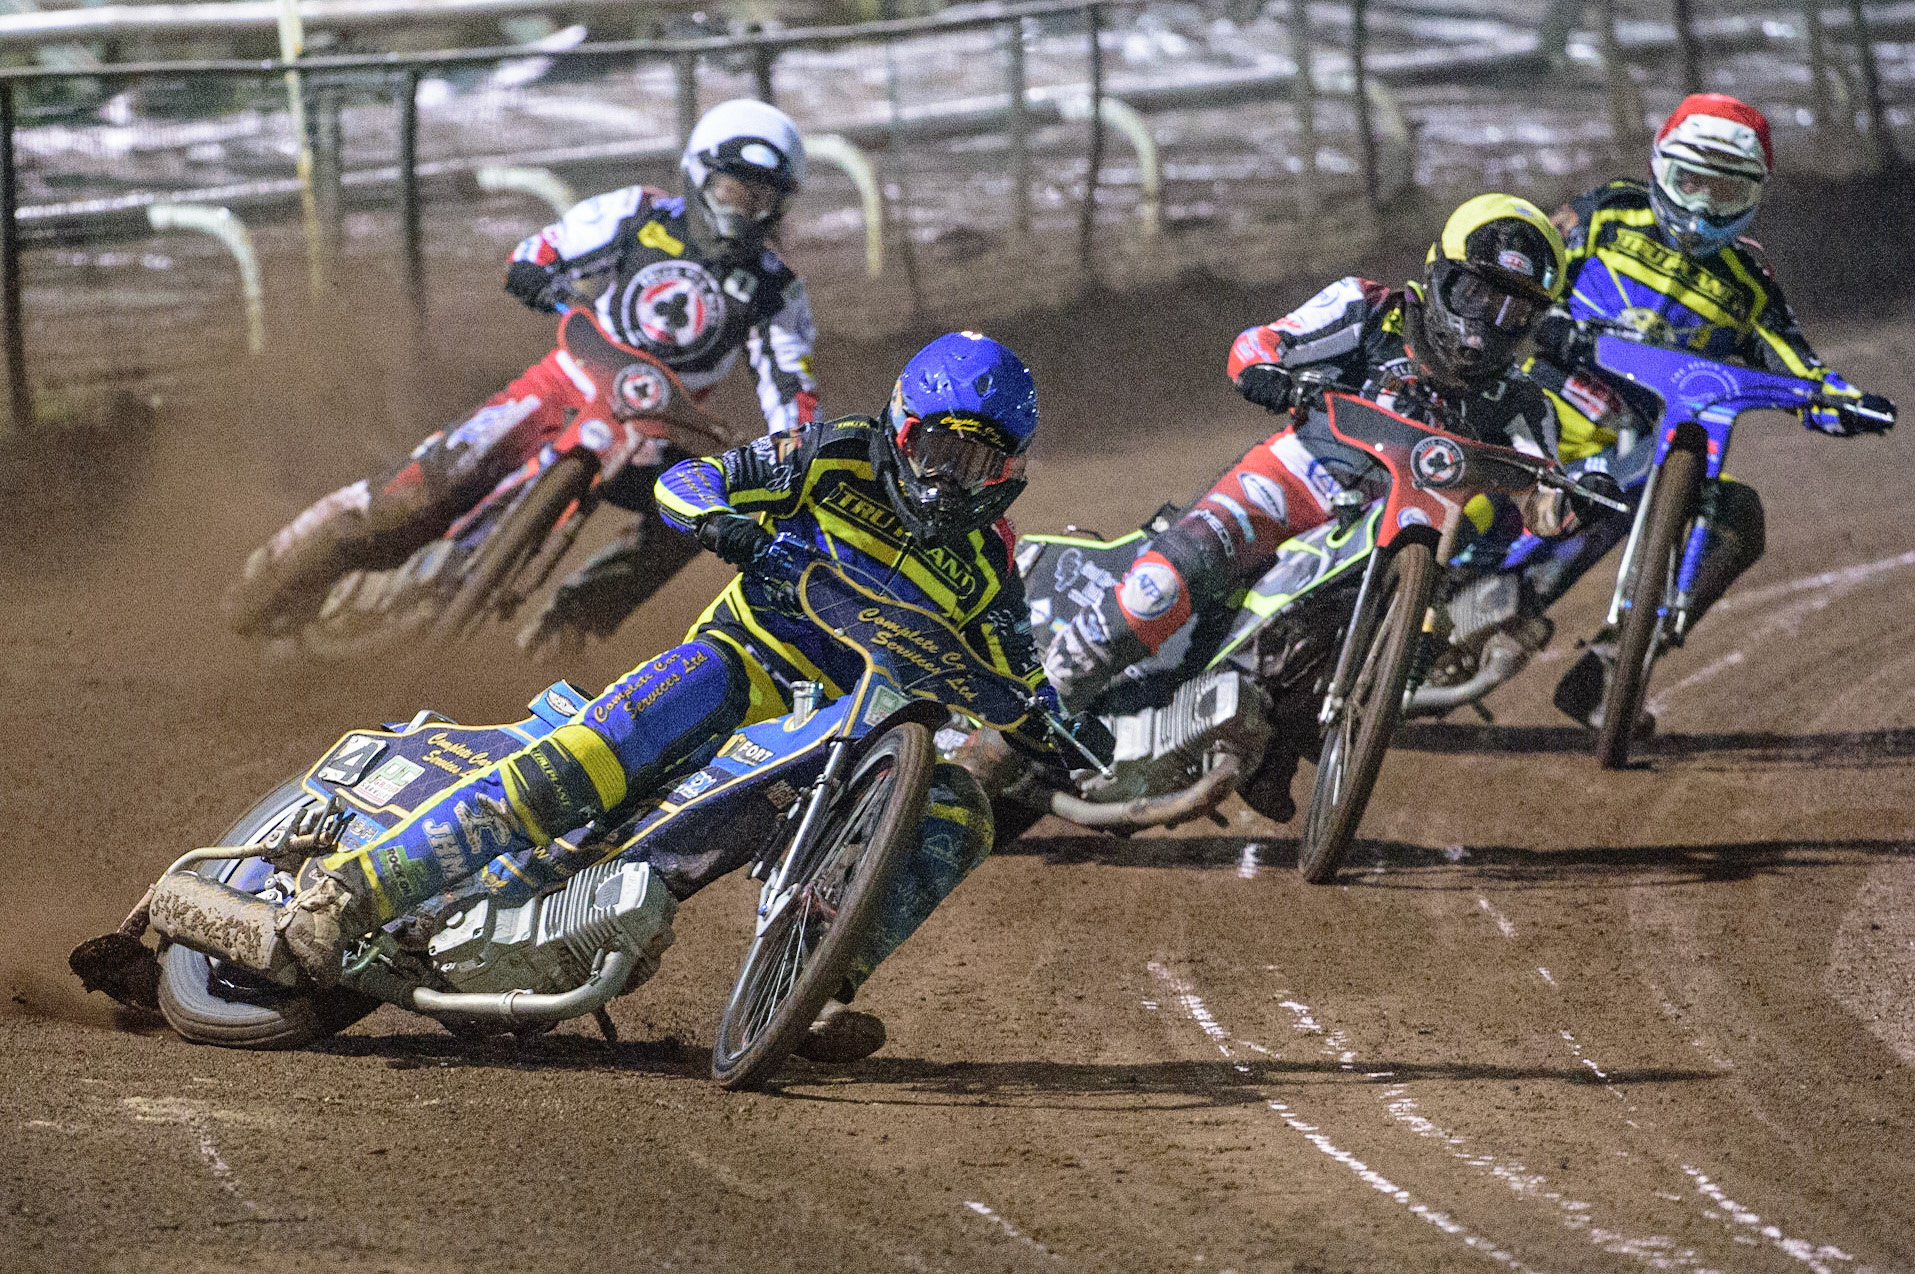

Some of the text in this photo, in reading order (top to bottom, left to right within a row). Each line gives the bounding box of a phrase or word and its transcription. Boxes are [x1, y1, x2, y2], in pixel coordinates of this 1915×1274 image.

[858, 607, 939, 653] Complete
[870, 631, 979, 702] Services Ltd
[594, 653, 682, 723] Complete Car
[623, 650, 709, 720] Services Ltd
[328, 742, 379, 782] 4
[421, 749, 462, 775] Services
[427, 732, 473, 760] Complete
[737, 740, 776, 763] FORT
[374, 778, 400, 794] GROUP
[386, 848, 406, 879] ROCK
